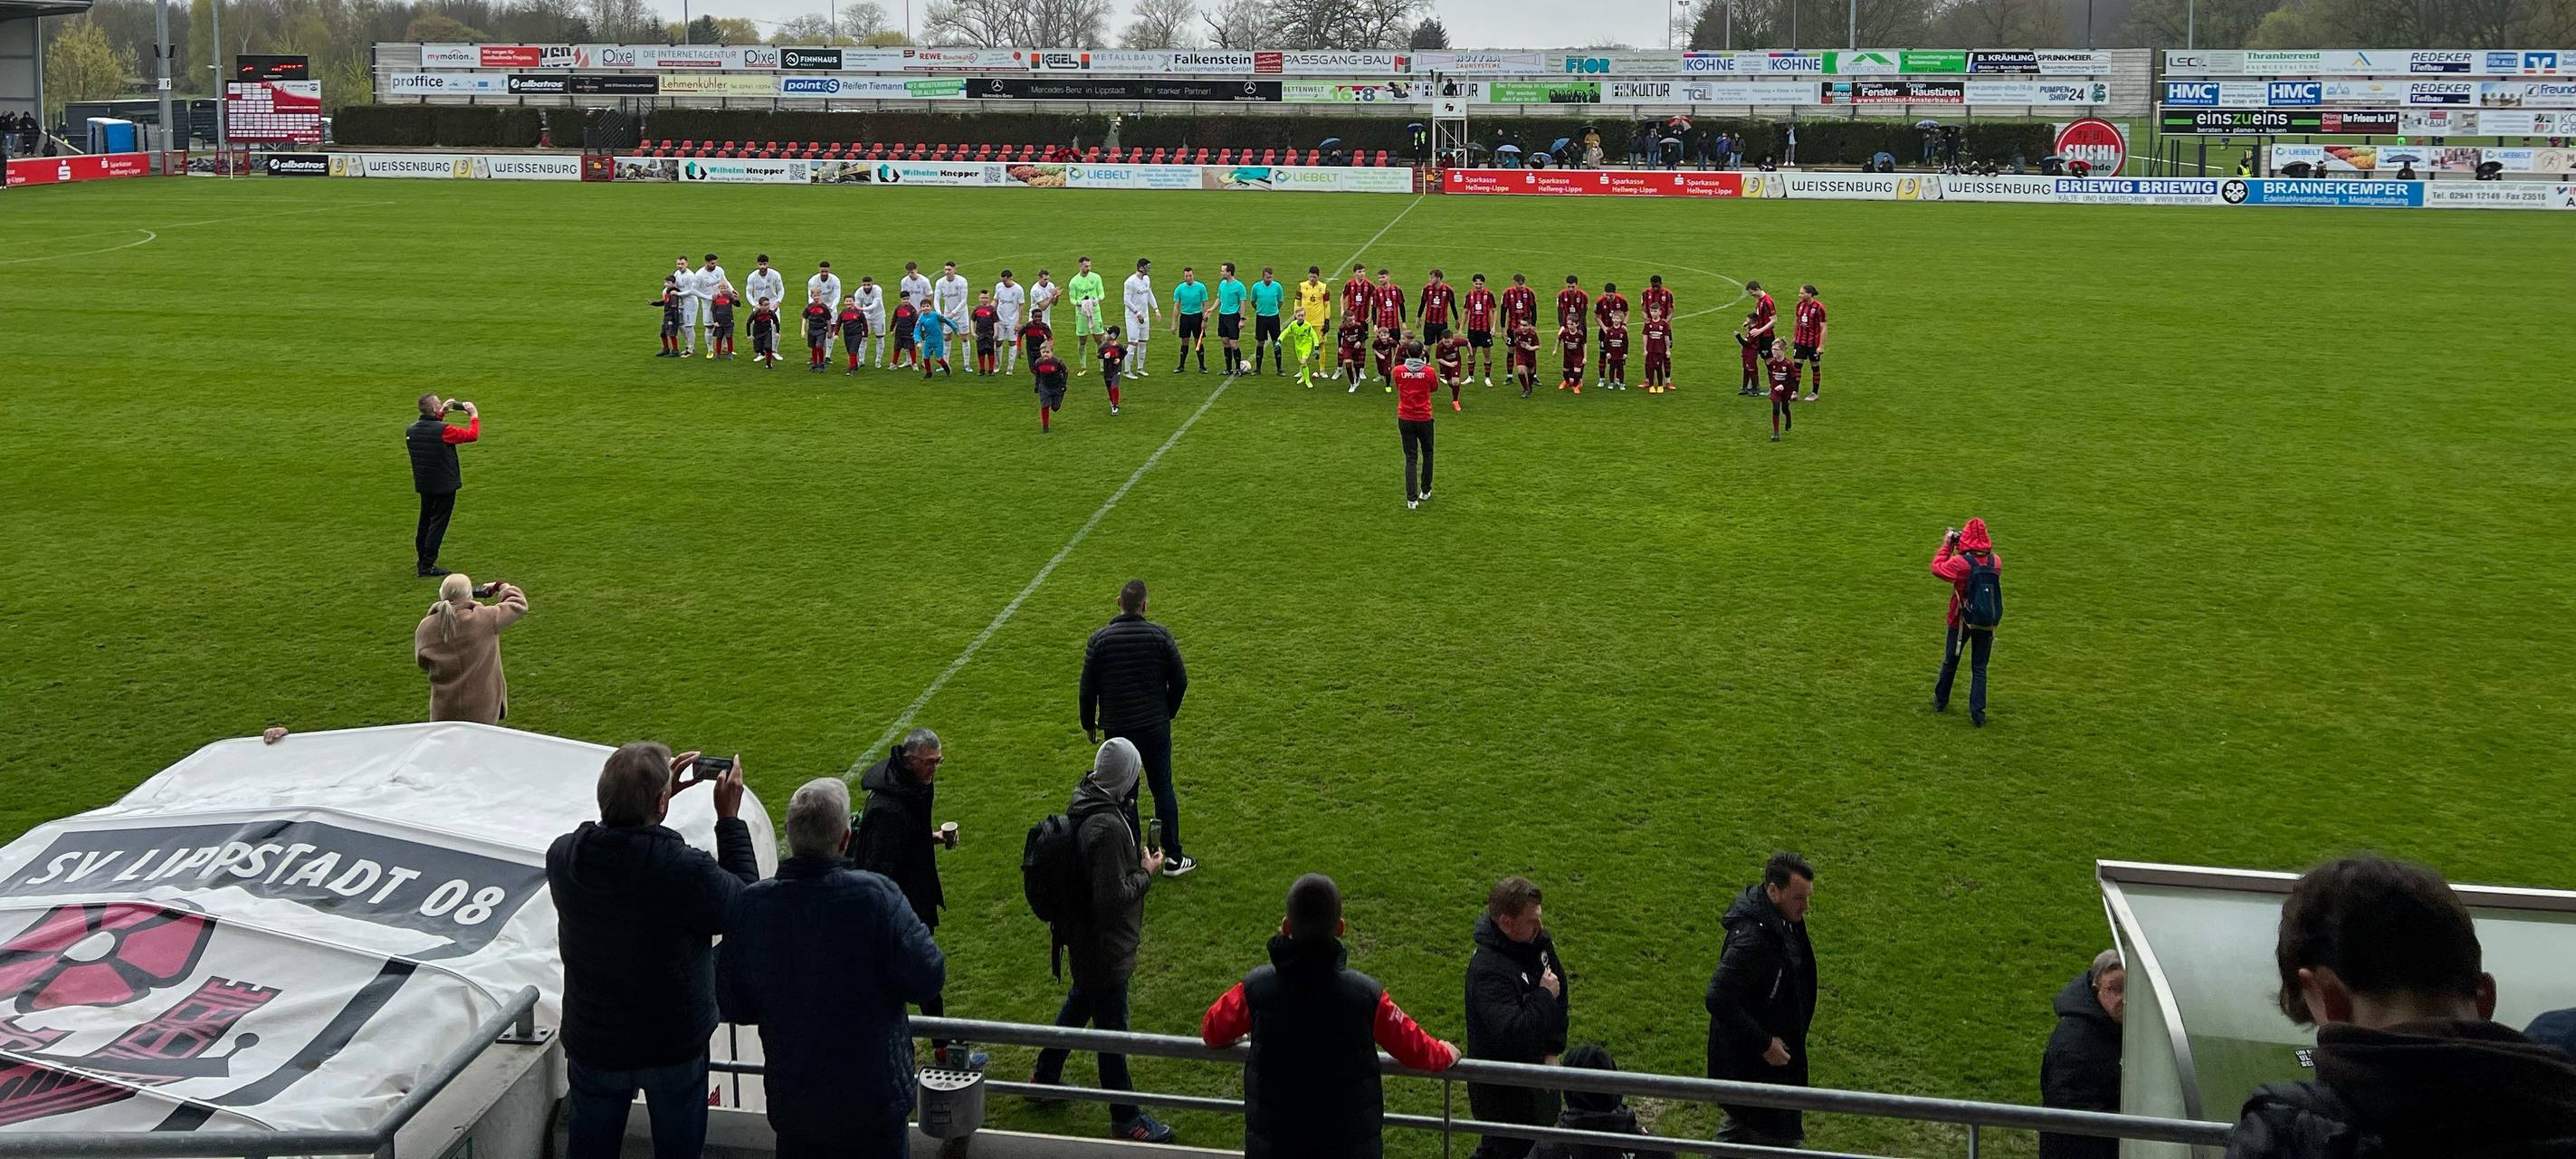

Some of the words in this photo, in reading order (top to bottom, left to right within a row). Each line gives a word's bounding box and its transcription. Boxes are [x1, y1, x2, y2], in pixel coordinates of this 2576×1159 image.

[658, 51, 737, 59] INTERNETAGENTUR
[1175, 54, 1252, 64] Falkenstein
[1283, 55, 1391, 65] PASSGANG-BAU
[1988, 53, 2035, 62] KRÄHLING
[2411, 53, 2472, 62] REDEKER
[1566, 58, 1609, 73] FIOR
[393, 76, 444, 89] proffice
[520, 80, 565, 88] albatros
[663, 76, 727, 89] Lehmenkühler
[787, 81, 822, 91] point
[842, 81, 867, 90] Reifen
[869, 81, 902, 91] Tiemann
[1906, 82, 1926, 91] Design
[2411, 83, 2471, 92] REDEKER
[1095, 86, 1126, 94] Lippstadt
[1613, 83, 1670, 97] FANKULTUR
[1683, 89, 1712, 101] TGL
[1910, 88, 1961, 96] Haustüren
[2069, 88, 2085, 101] 24
[2049, 93, 2069, 101] SHOP
[2412, 94, 2444, 102] Tiefbau
[2197, 110, 2288, 125] einszueins
[2342, 114, 2352, 122] Ihr
[2353, 114, 2377, 122] Friseur
[2378, 114, 2384, 122] in
[2386, 114, 2397, 122] LP!
[2066, 145, 2115, 160] SUSHI
[281, 159, 326, 168] albatros
[369, 161, 450, 172] WEISSENBURG
[495, 163, 577, 174] WEISSENBURG
[746, 167, 785, 176] Knepper
[940, 170, 979, 178] Knepper
[1088, 169, 1131, 179] LIEBELT
[1293, 173, 1339, 182] LIEBELT
[1687, 187, 1732, 196] Hellweg-Lippe
[1792, 181, 1893, 192] WEISSENBURG
[1950, 183, 2051, 194] WEISSENBURG
[2058, 180, 2132, 192] BRIEWIG
[2139, 181, 2214, 194] BRIEWIG
[2264, 182, 2408, 196] BRANNEKEMPER
[2099, 195, 2147, 203] KLIMATECHNIK
[2154, 195, 2213, 203] WWW.BRIEWIG.DE
[2264, 196, 2339, 206] Edelstahlverarbeitung
[2349, 196, 2409, 206] Metallgestaltung
[25, 849, 124, 886] SV
[115, 840, 422, 905] LIPPSTADT
[419, 877, 505, 926] 08
